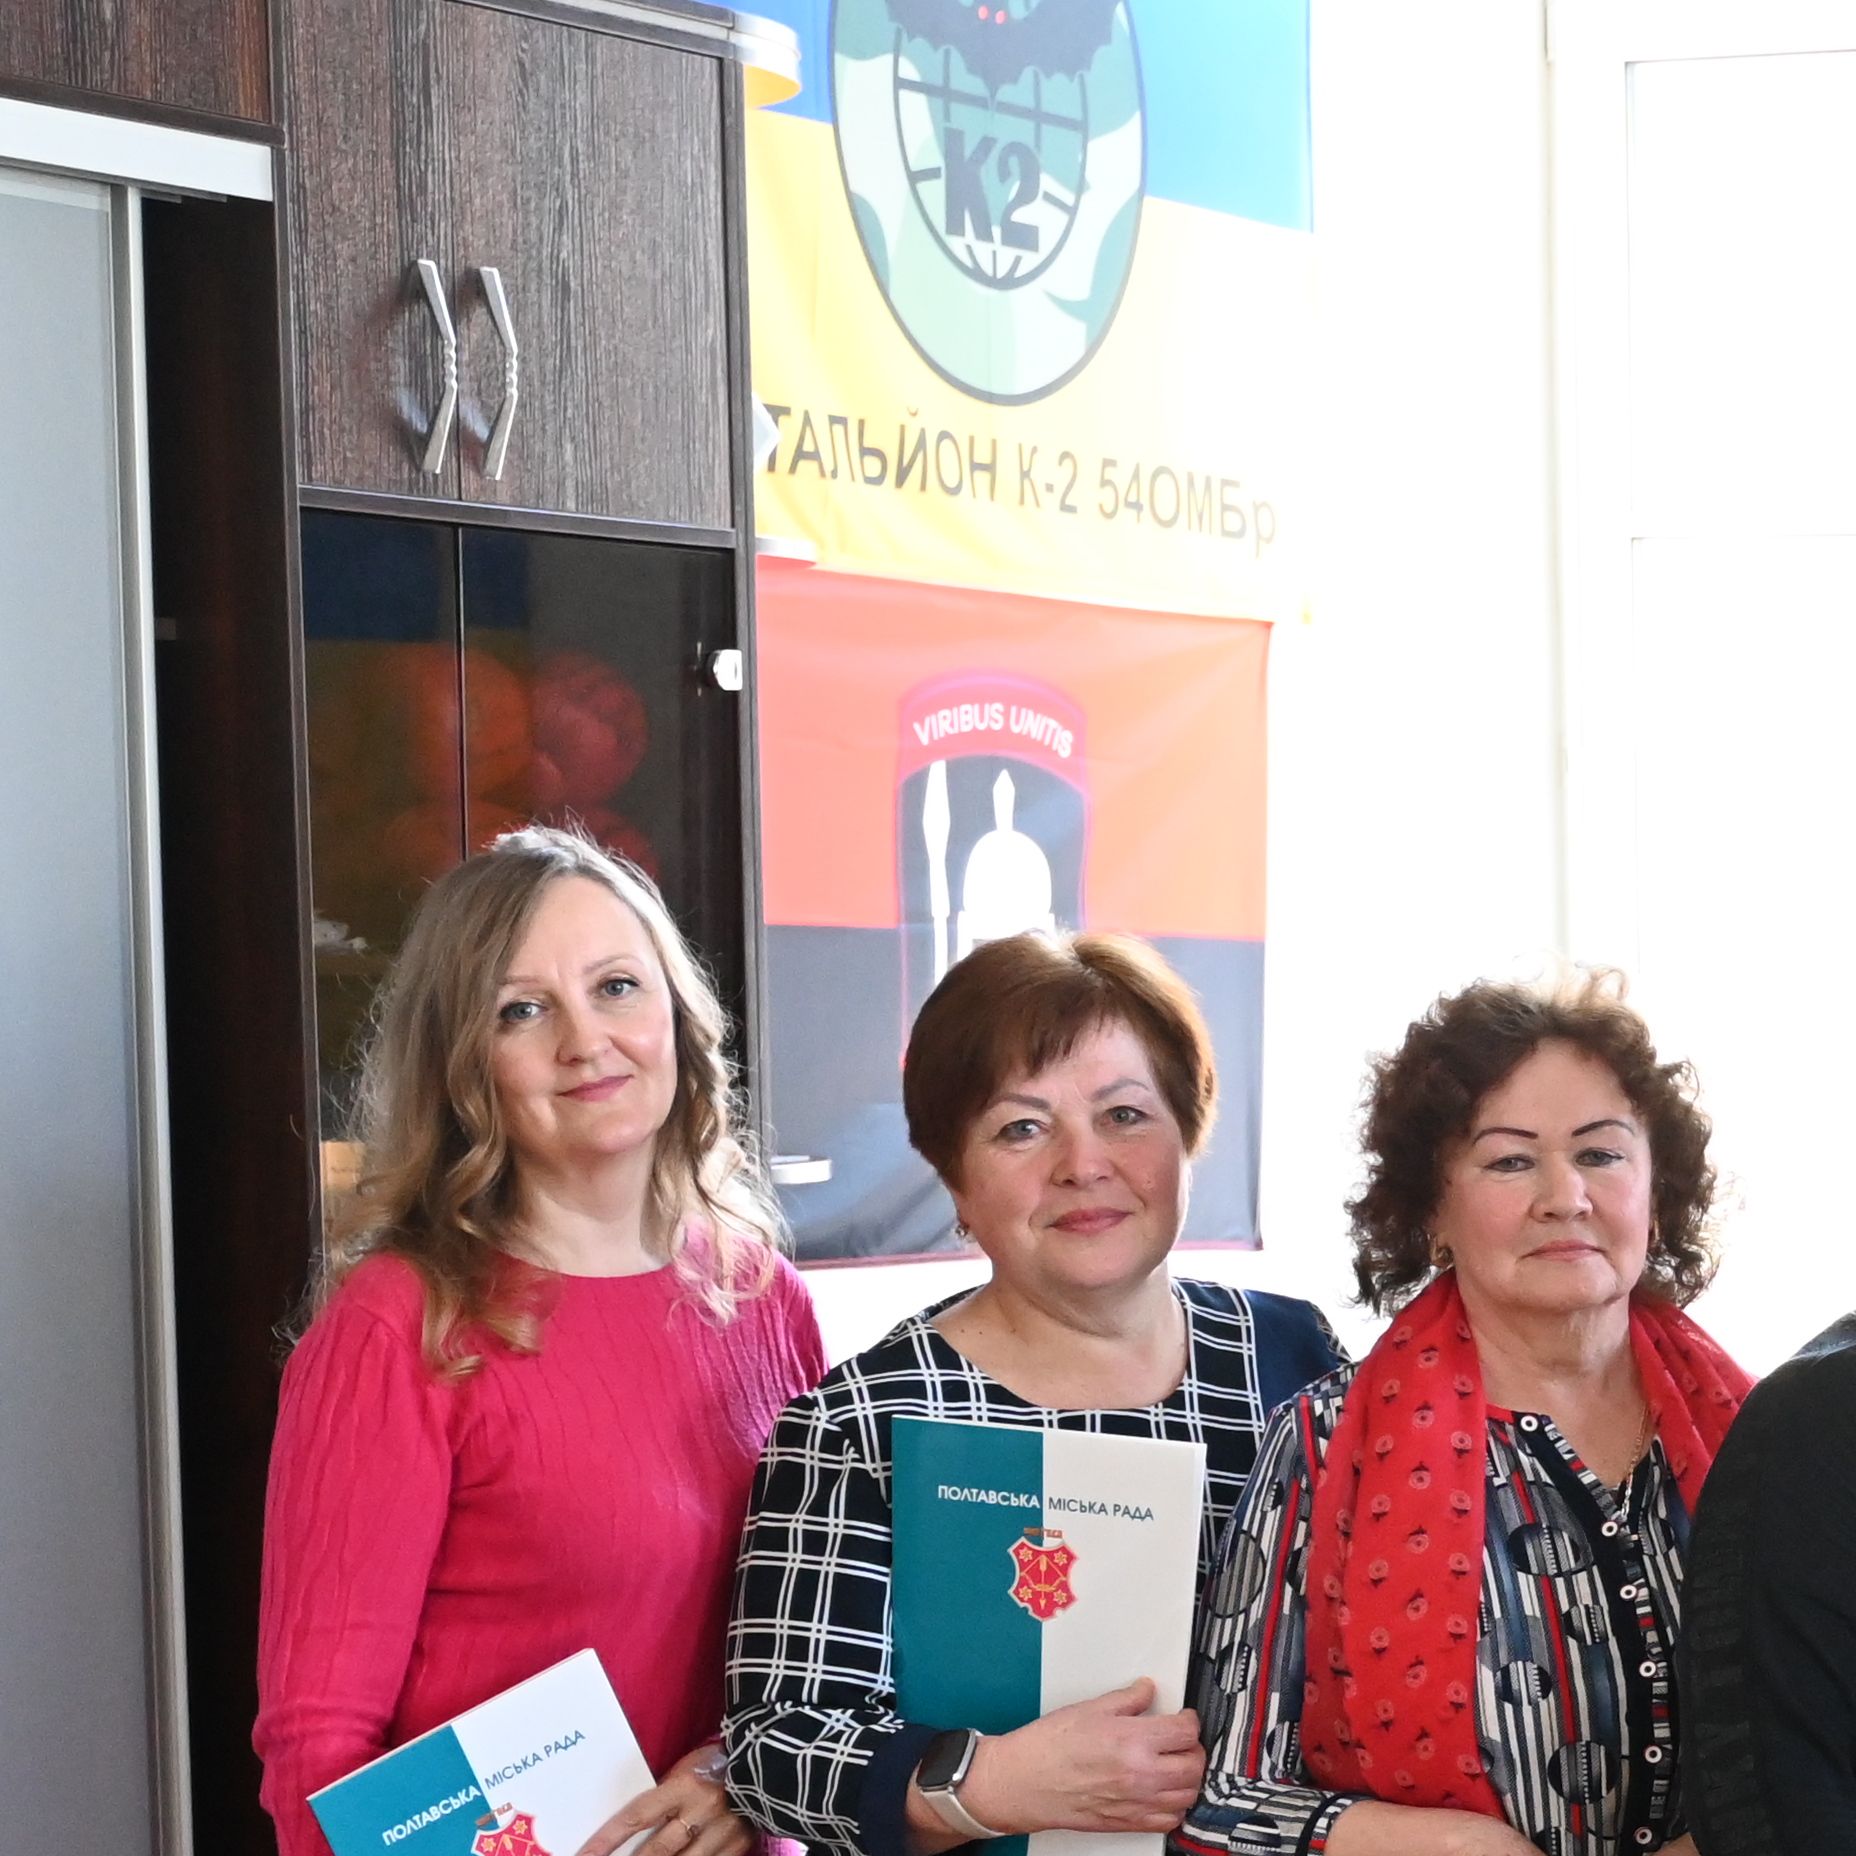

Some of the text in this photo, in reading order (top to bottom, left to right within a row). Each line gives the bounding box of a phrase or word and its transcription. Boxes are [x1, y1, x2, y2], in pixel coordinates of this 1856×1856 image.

[1018, 442, 1078, 514] К-2
[912, 702, 1073, 758] VIRIBUS UNITIS
[937, 1484, 1155, 1521] ПОЛТАВСЬКА МІСЬКА РАДА
[381, 1785, 482, 1847] ПОЛТАВСЬКА
[484, 1752, 543, 1791] МІСЬКА
[544, 1729, 586, 1758] РАДА
